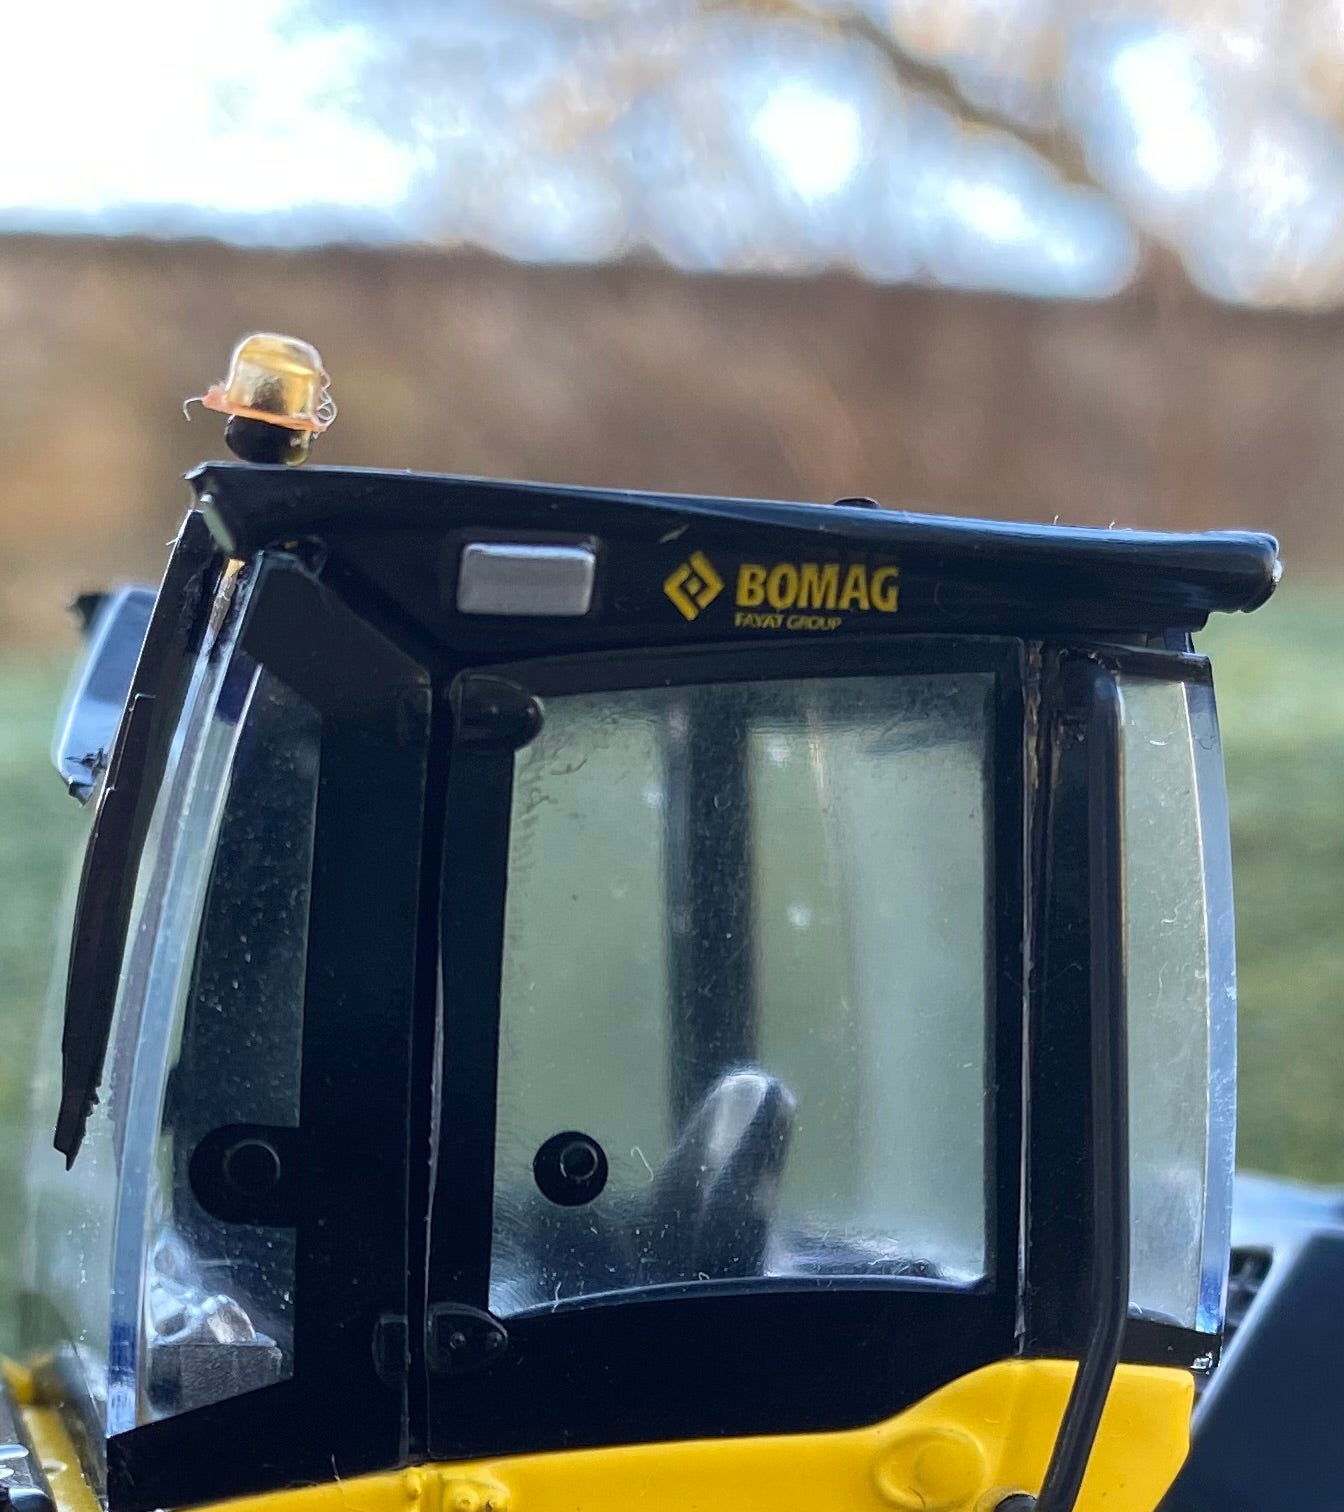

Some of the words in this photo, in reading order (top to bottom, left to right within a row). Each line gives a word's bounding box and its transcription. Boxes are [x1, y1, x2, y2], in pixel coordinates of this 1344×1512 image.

[735, 564, 900, 613] BOMAG
[734, 612, 783, 628] FAYAT
[786, 614, 843, 631] GROUP
